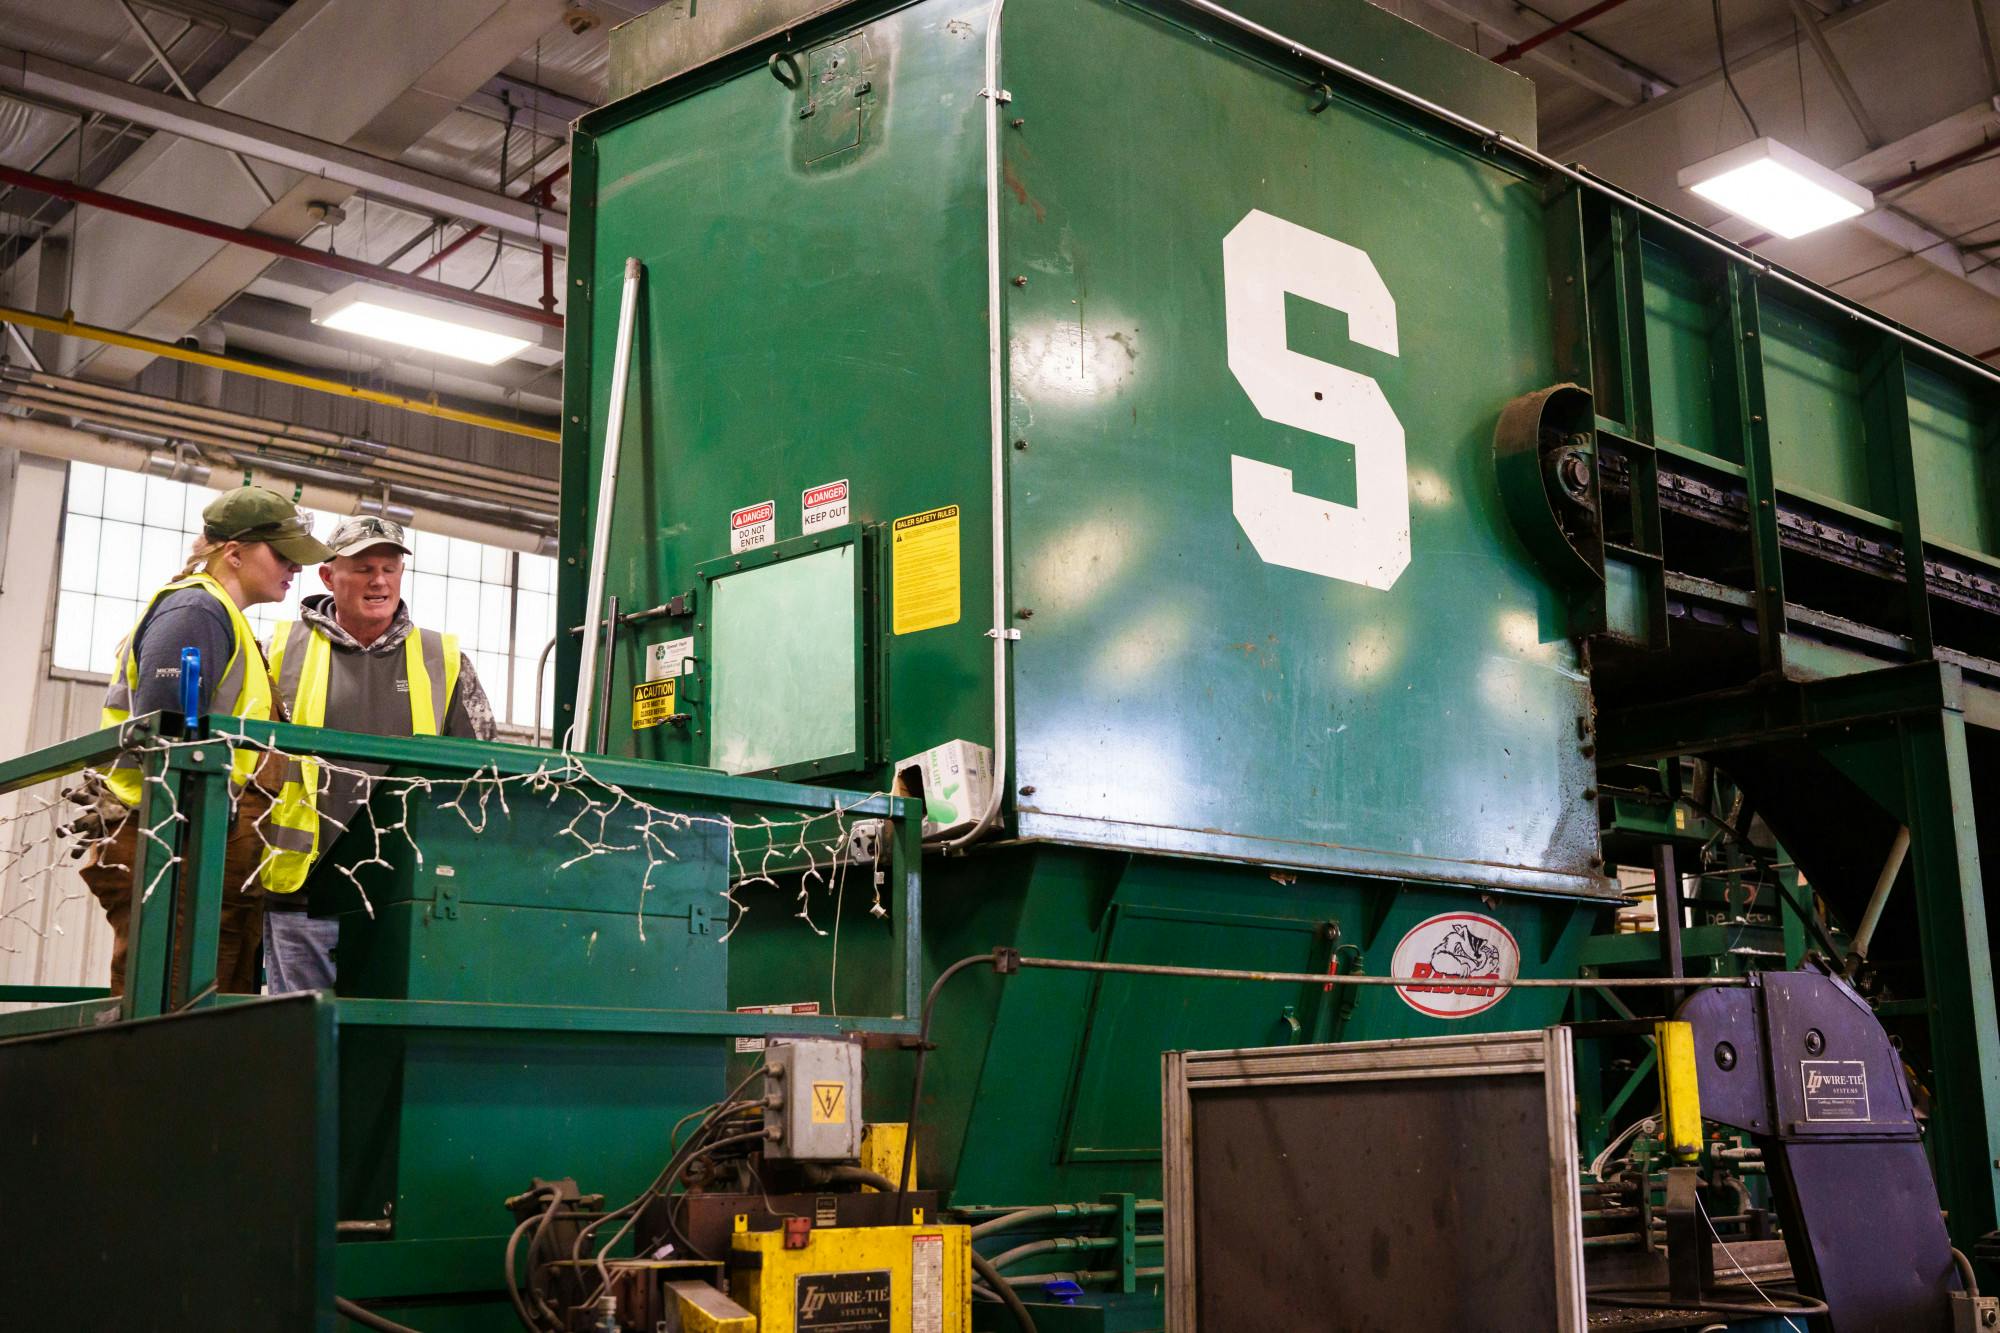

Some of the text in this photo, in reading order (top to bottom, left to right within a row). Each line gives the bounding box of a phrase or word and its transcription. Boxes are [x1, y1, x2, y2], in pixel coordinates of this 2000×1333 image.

[1223, 208, 1411, 591] S
[813, 486, 844, 502] DANGER
[742, 507, 770, 523] DANGER
[805, 506, 847, 525] KEEP OUT
[896, 508, 956, 529] BALER SAFETY RULES
[740, 525, 766, 539] DO NOT
[740, 535, 765, 547] ENTER
[643, 682, 673, 698] CAUTION
[1823, 1075, 1864, 1085] WIRE-TIE
[827, 1288, 890, 1305] WIRE-TIE
[841, 1307, 878, 1316] SYSTEMS
